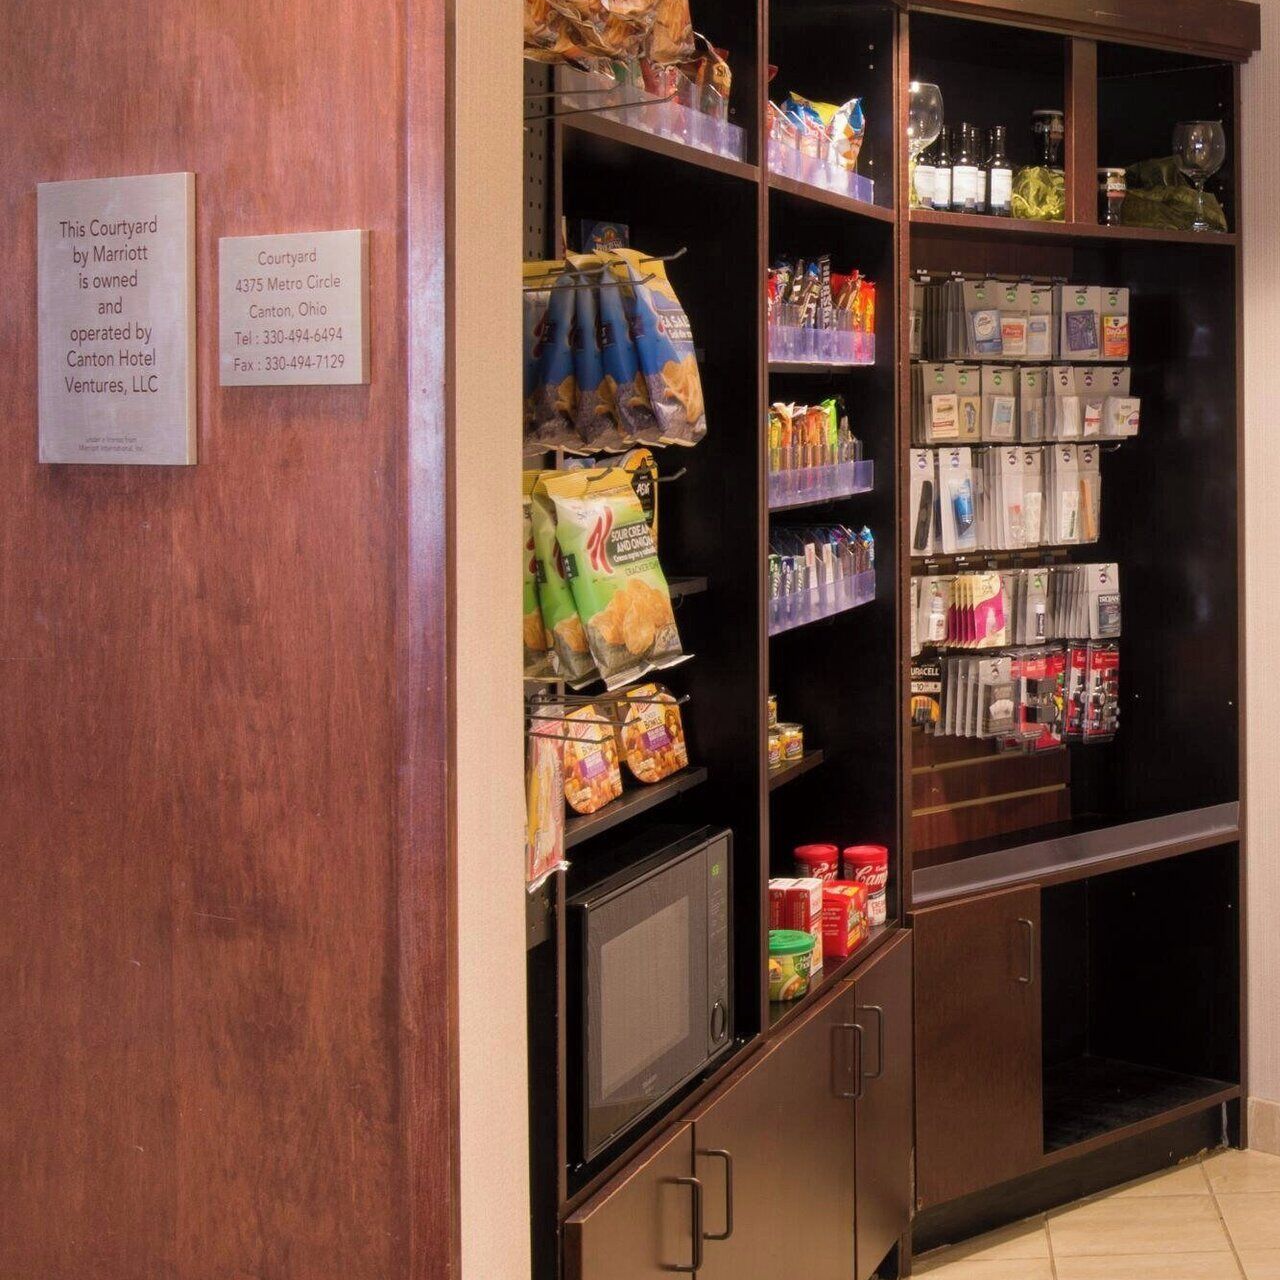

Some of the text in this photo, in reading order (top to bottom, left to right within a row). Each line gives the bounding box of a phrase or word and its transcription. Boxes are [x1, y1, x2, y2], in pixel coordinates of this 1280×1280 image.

[60, 215, 158, 239] This Courtyard
[73, 244, 148, 268] by Marriott
[258, 248, 317, 267] Courtyard
[79, 270, 138, 289] is owned
[235, 273, 341, 293] 4375 Metro Circle
[98, 296, 123, 314] and
[249, 302, 327, 319] Canton, Ohio
[70, 322, 152, 346] operated by
[263, 327, 343, 345] 330-494-6494
[66, 348, 156, 367] Canton Hotel
[264, 354, 345, 371] 330-494-7129
[65, 374, 158, 396] Ventures, LLC
[617, 540, 631, 553] AND
[911, 666, 940, 676] URACELL
